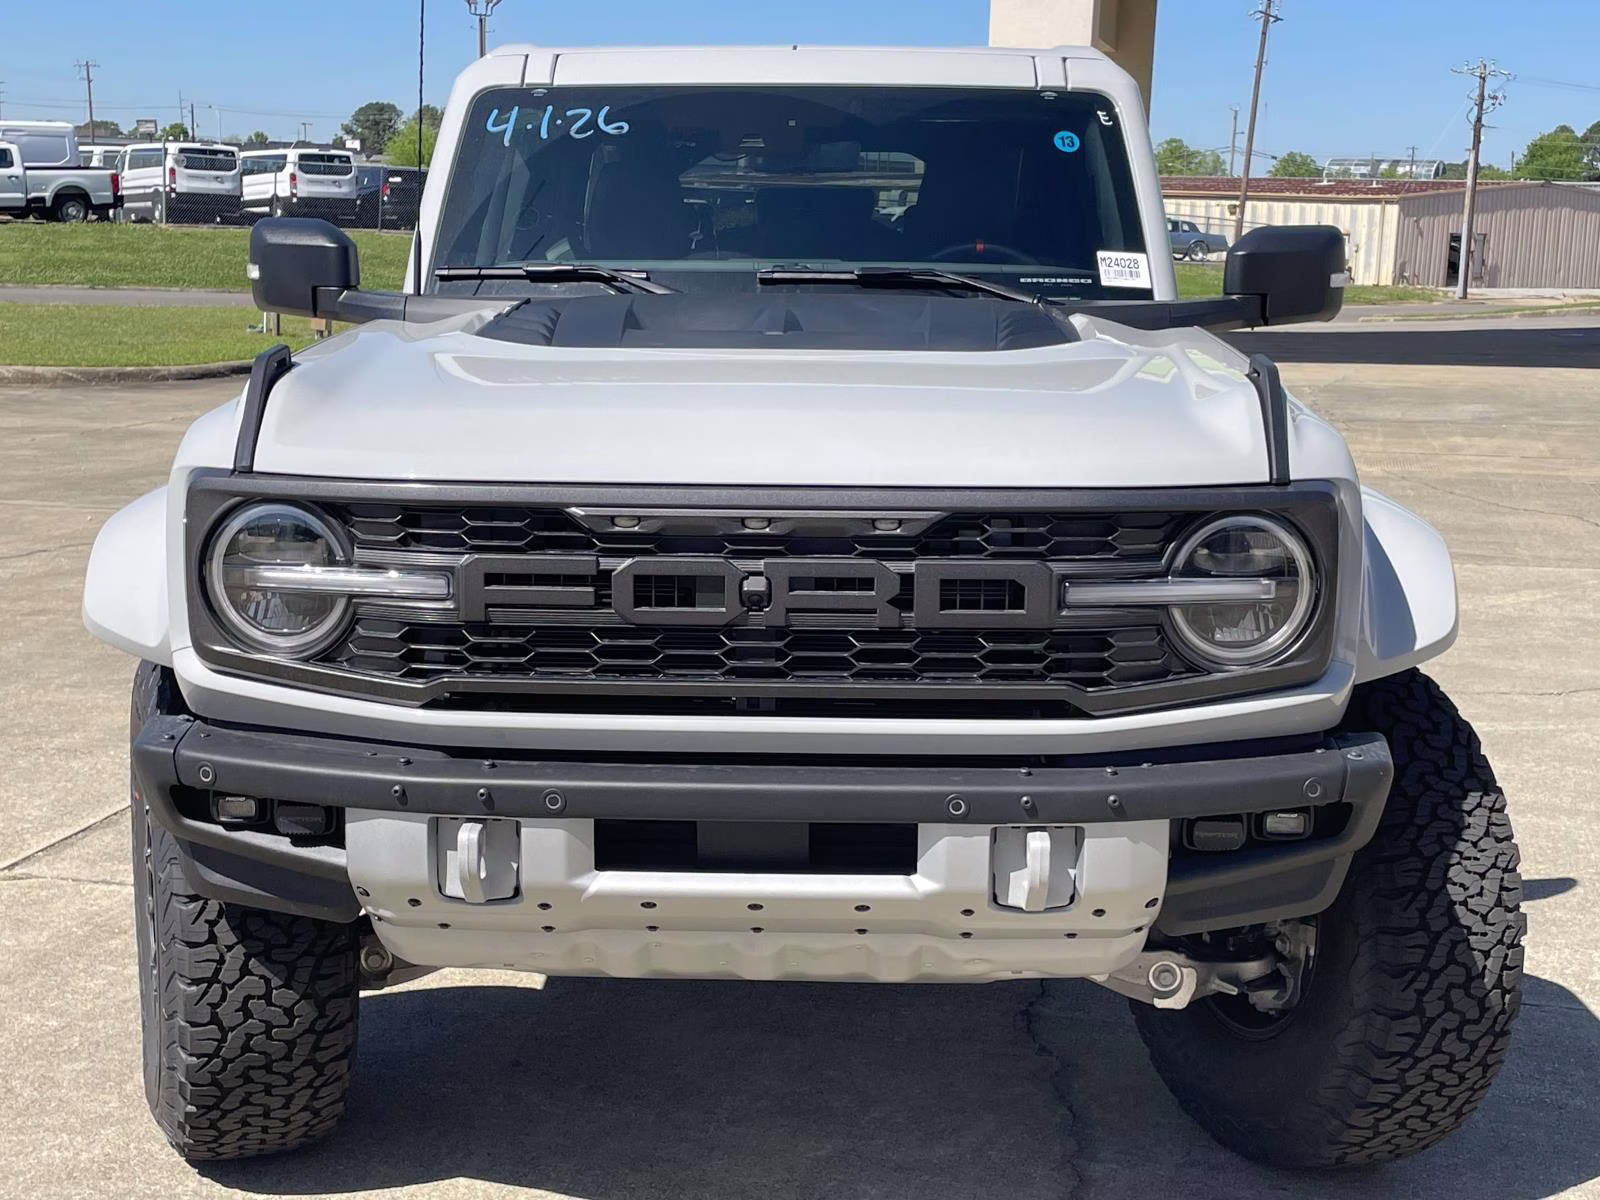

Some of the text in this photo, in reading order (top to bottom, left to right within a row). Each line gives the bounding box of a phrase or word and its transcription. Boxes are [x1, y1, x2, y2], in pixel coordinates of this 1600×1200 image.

[1058, 135, 1076, 148] 13
[1099, 256, 1140, 270] M24028
[459, 554, 1056, 629] FORD
